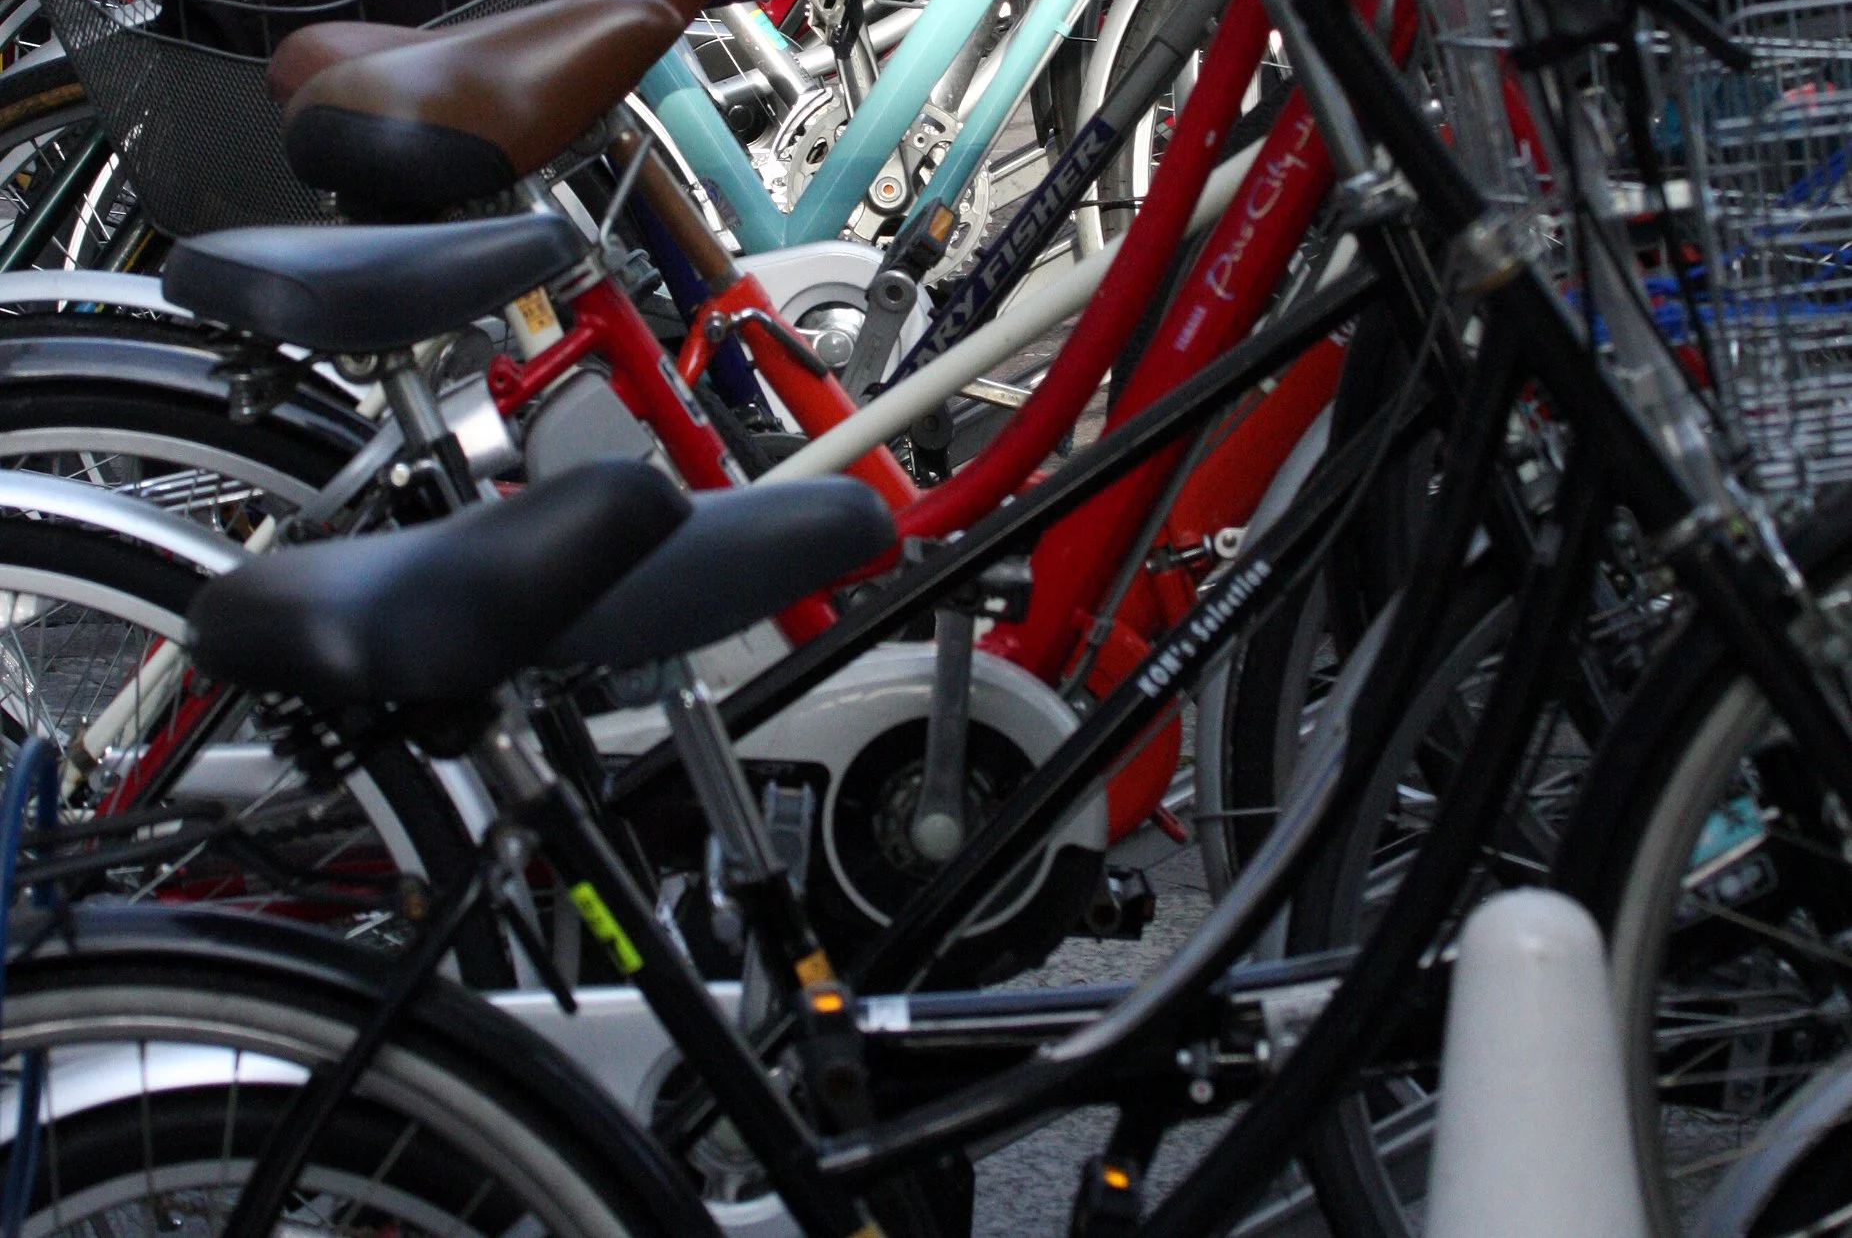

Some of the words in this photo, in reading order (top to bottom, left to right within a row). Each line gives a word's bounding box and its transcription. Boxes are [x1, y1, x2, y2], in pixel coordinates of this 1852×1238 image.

[905, 288, 974, 374] ARY
[980, 128, 1109, 289] FISHER
[1190, 559, 1272, 642] Selection
